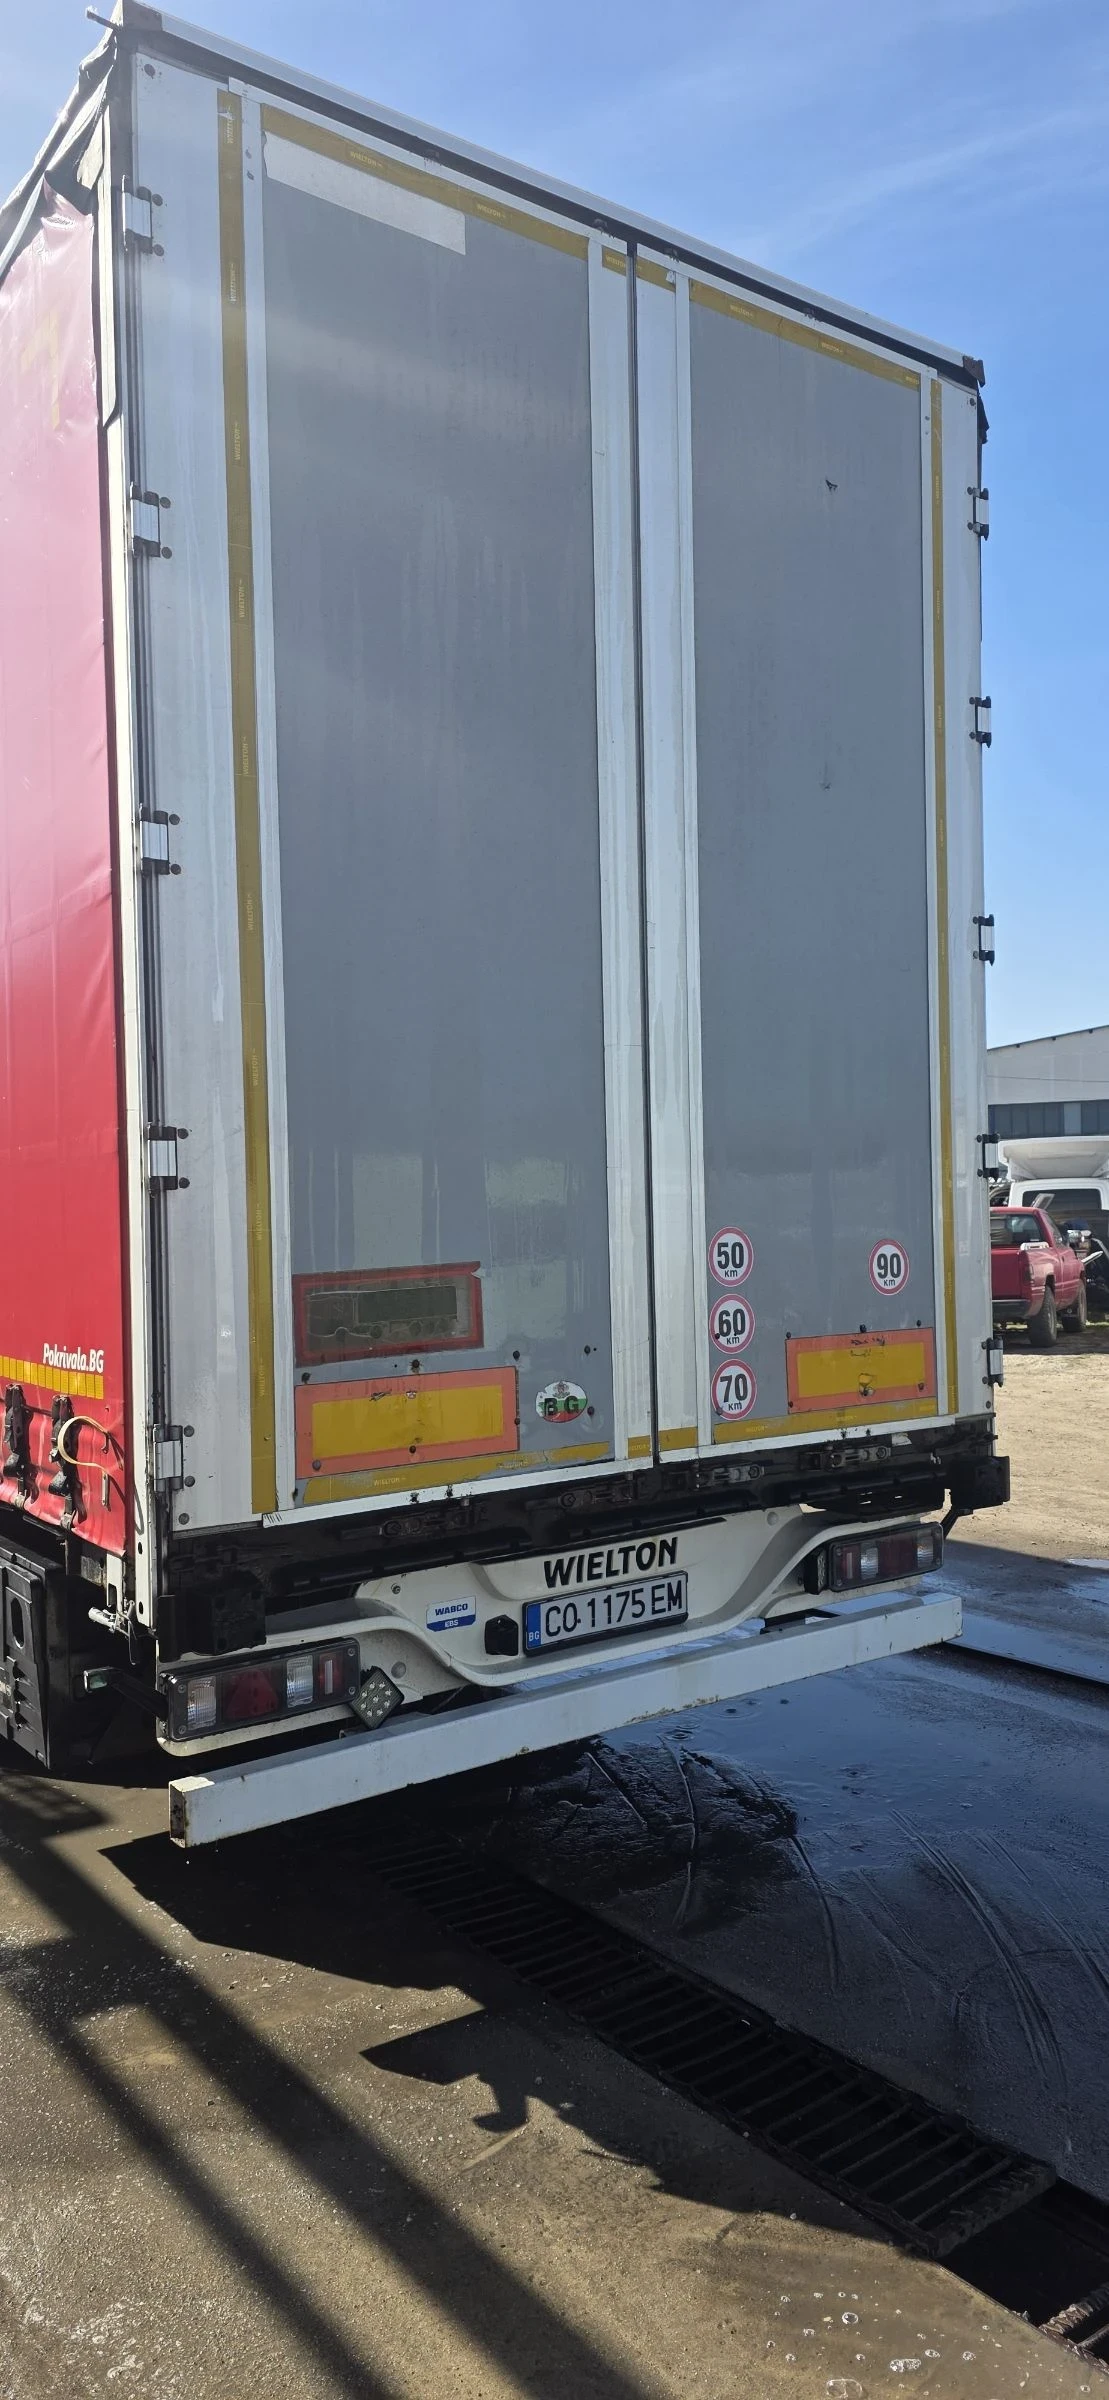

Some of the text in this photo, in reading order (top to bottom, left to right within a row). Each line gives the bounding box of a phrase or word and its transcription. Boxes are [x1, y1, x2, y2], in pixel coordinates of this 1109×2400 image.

[717, 1242, 744, 1269] 50
[876, 1252, 902, 1279] 90
[718, 1308, 746, 1337] 60
[43, 1342, 104, 1373] Pokrivala.BG
[720, 1373, 748, 1403] 70
[543, 1537, 679, 1588] WIELTON
[435, 1603, 468, 1616] WABCO
[587, 1588, 646, 1628] 1175
[650, 1580, 683, 1615] EM
[444, 1619, 459, 1628] EBS
[528, 1631, 540, 1641] BG
